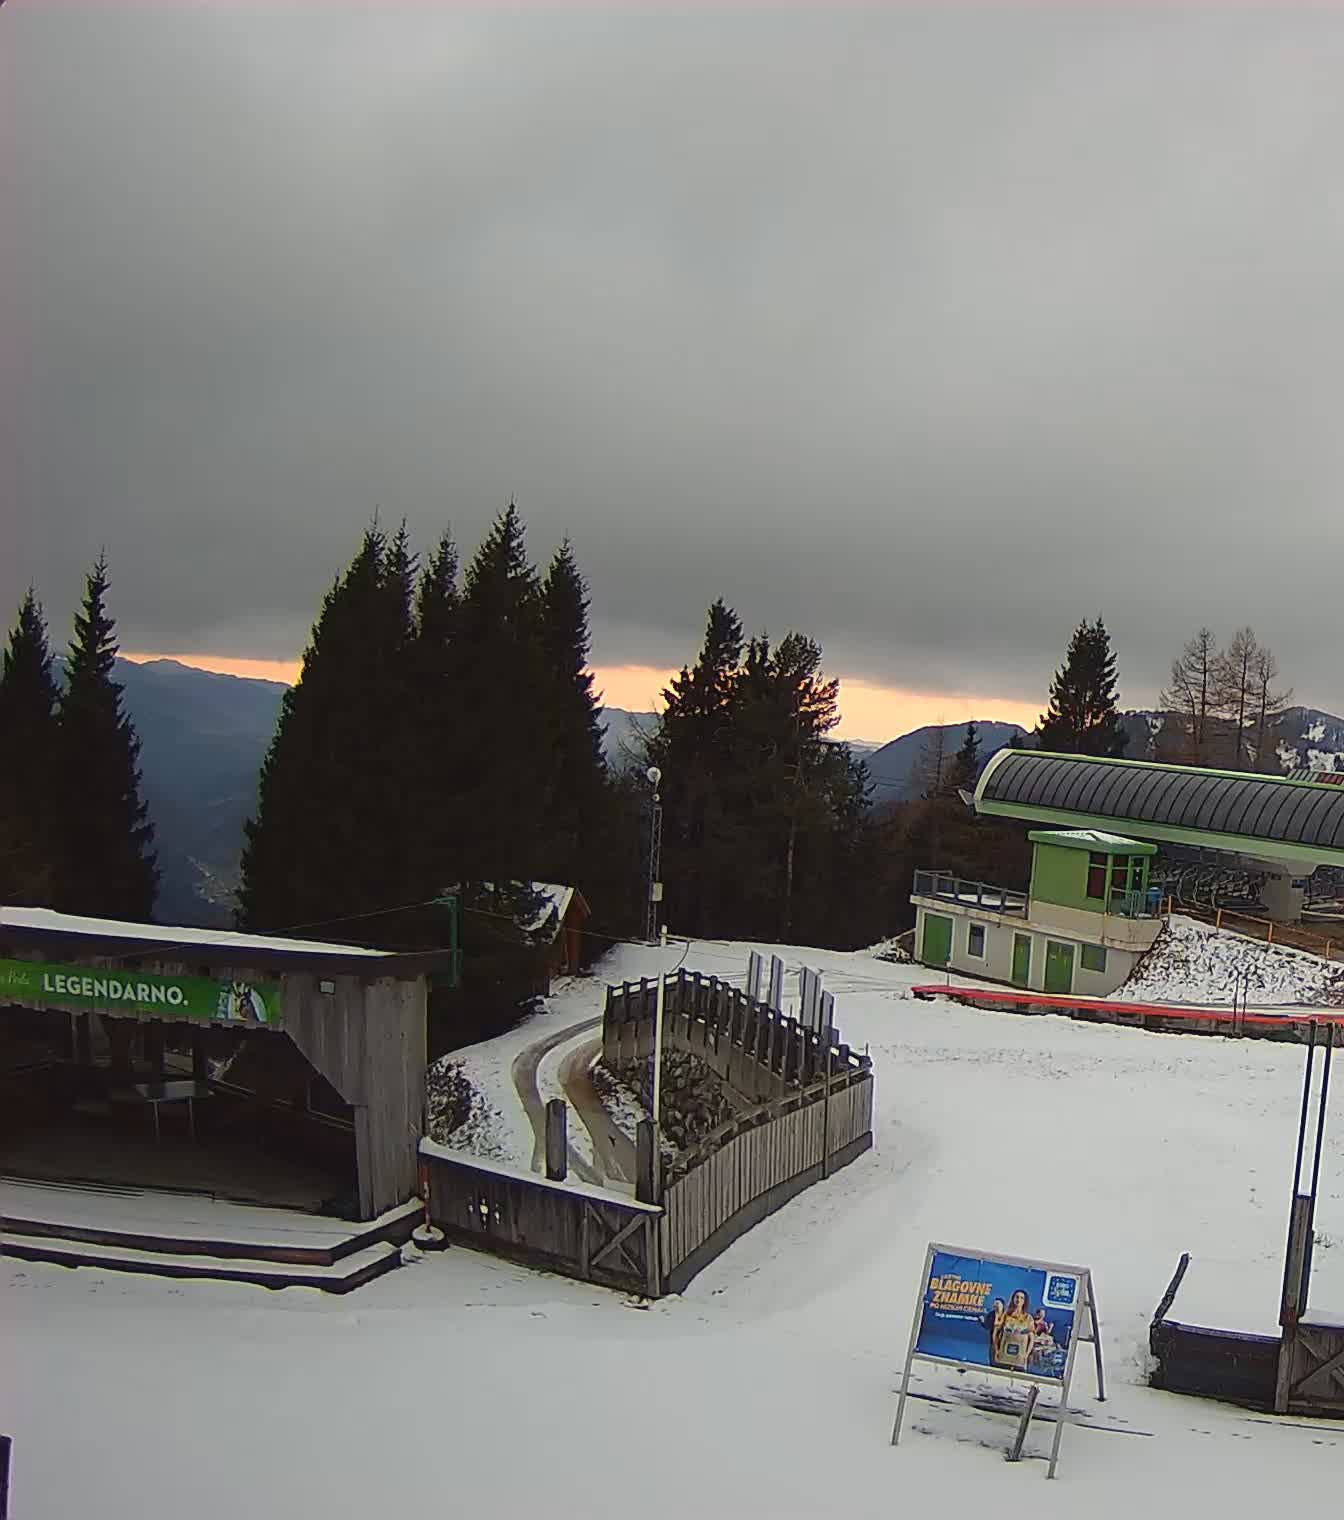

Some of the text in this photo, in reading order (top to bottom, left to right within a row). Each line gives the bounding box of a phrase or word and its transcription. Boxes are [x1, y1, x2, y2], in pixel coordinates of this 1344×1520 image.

[43, 973, 189, 1006] LEGENDARNO.
[930, 1277, 993, 1295] BLAGOVNE
[932, 1290, 985, 1306] ZNAMKE
